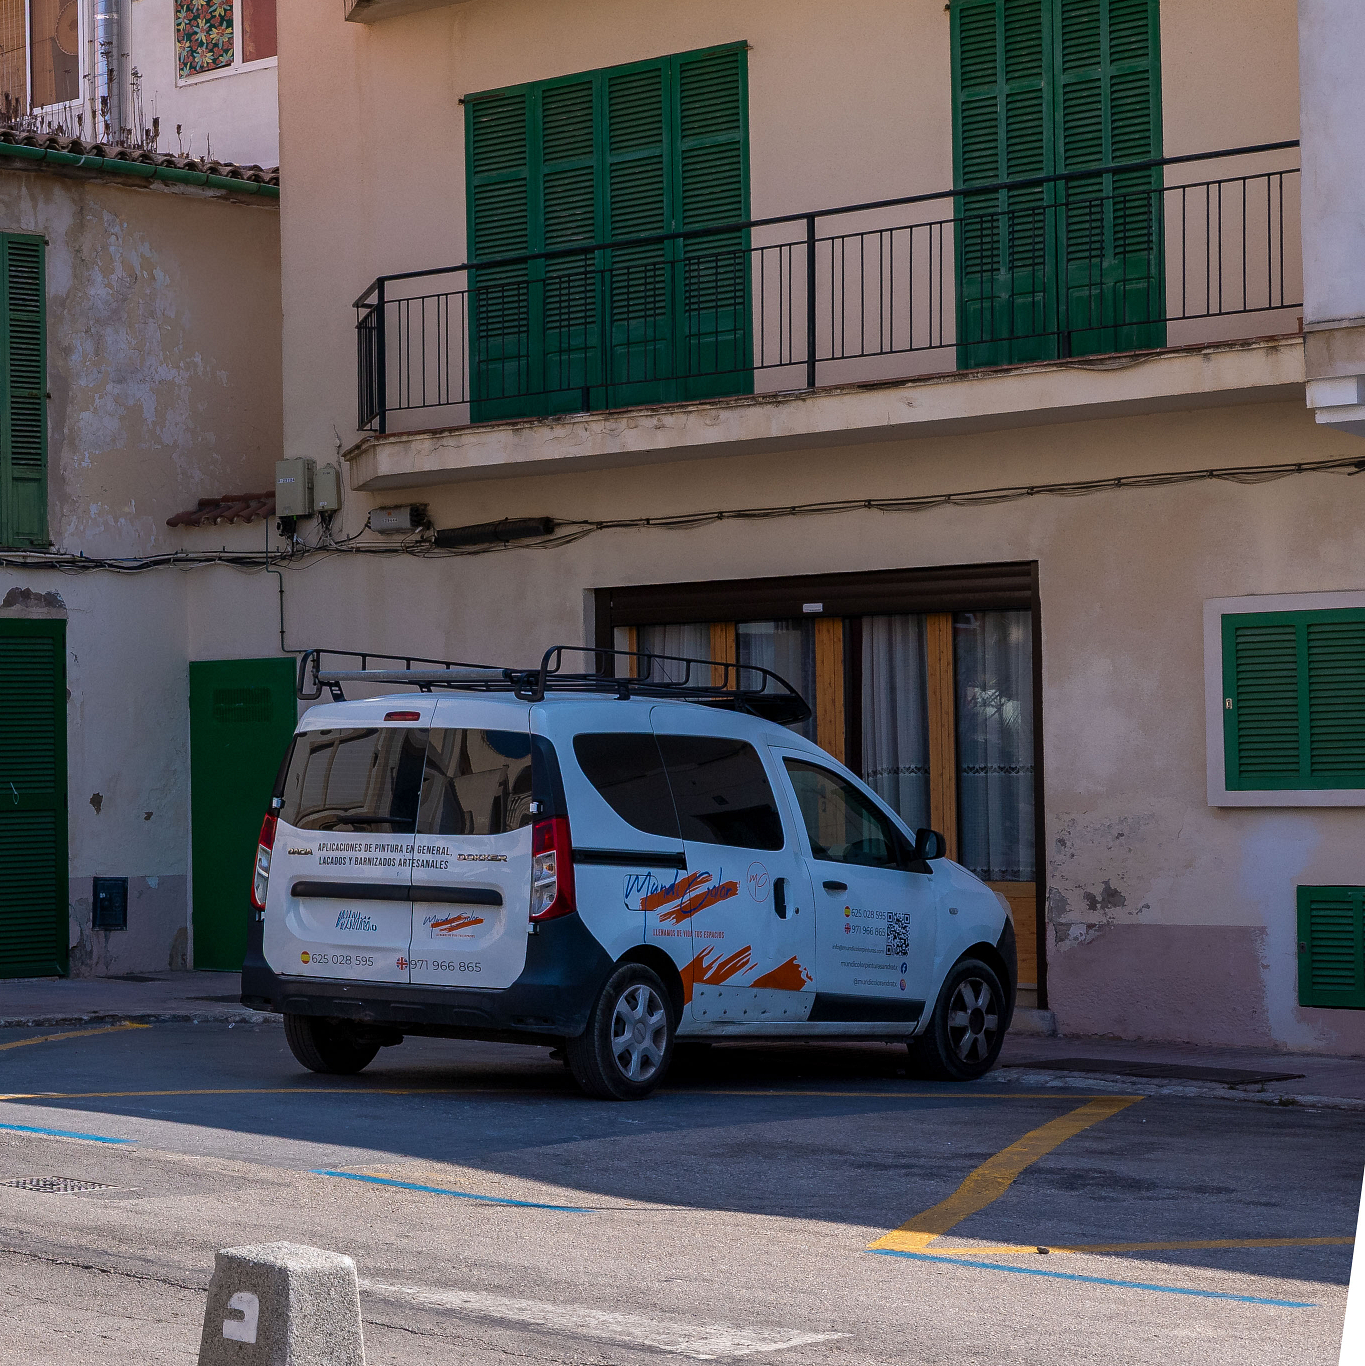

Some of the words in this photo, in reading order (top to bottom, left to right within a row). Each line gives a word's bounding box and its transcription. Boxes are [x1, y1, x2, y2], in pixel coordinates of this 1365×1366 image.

[317, 843, 362, 853] APLICACIONES
[364, 844, 373, 852] DE
[374, 844, 404, 853] PINTURA
[405, 844, 415, 854] EN
[417, 845, 453, 857] GENERAL,
[318, 856, 347, 866] LACADOS
[348, 857, 353, 865] Y
[354, 857, 396, 867] BARNIZADOS
[398, 858, 449, 869] ARTESANALES
[456, 853, 508, 862] DOKKER
[851, 908, 862, 918] 625
[863, 909, 875, 919] 028
[875, 910, 886, 921] 595
[653, 928, 675, 937] LLENAMOS
[676, 929, 682, 937] DE
[683, 930, 692, 938] VIDA
[694, 930, 703, 938] TUS
[703, 930, 725, 939] ESPACIOS
[311, 953, 329, 964] 625
[331, 954, 352, 965] 028
[355, 955, 374, 967] 595
[410, 959, 428, 970] 971
[432, 960, 455, 971] 966
[458, 961, 482, 972] 865
